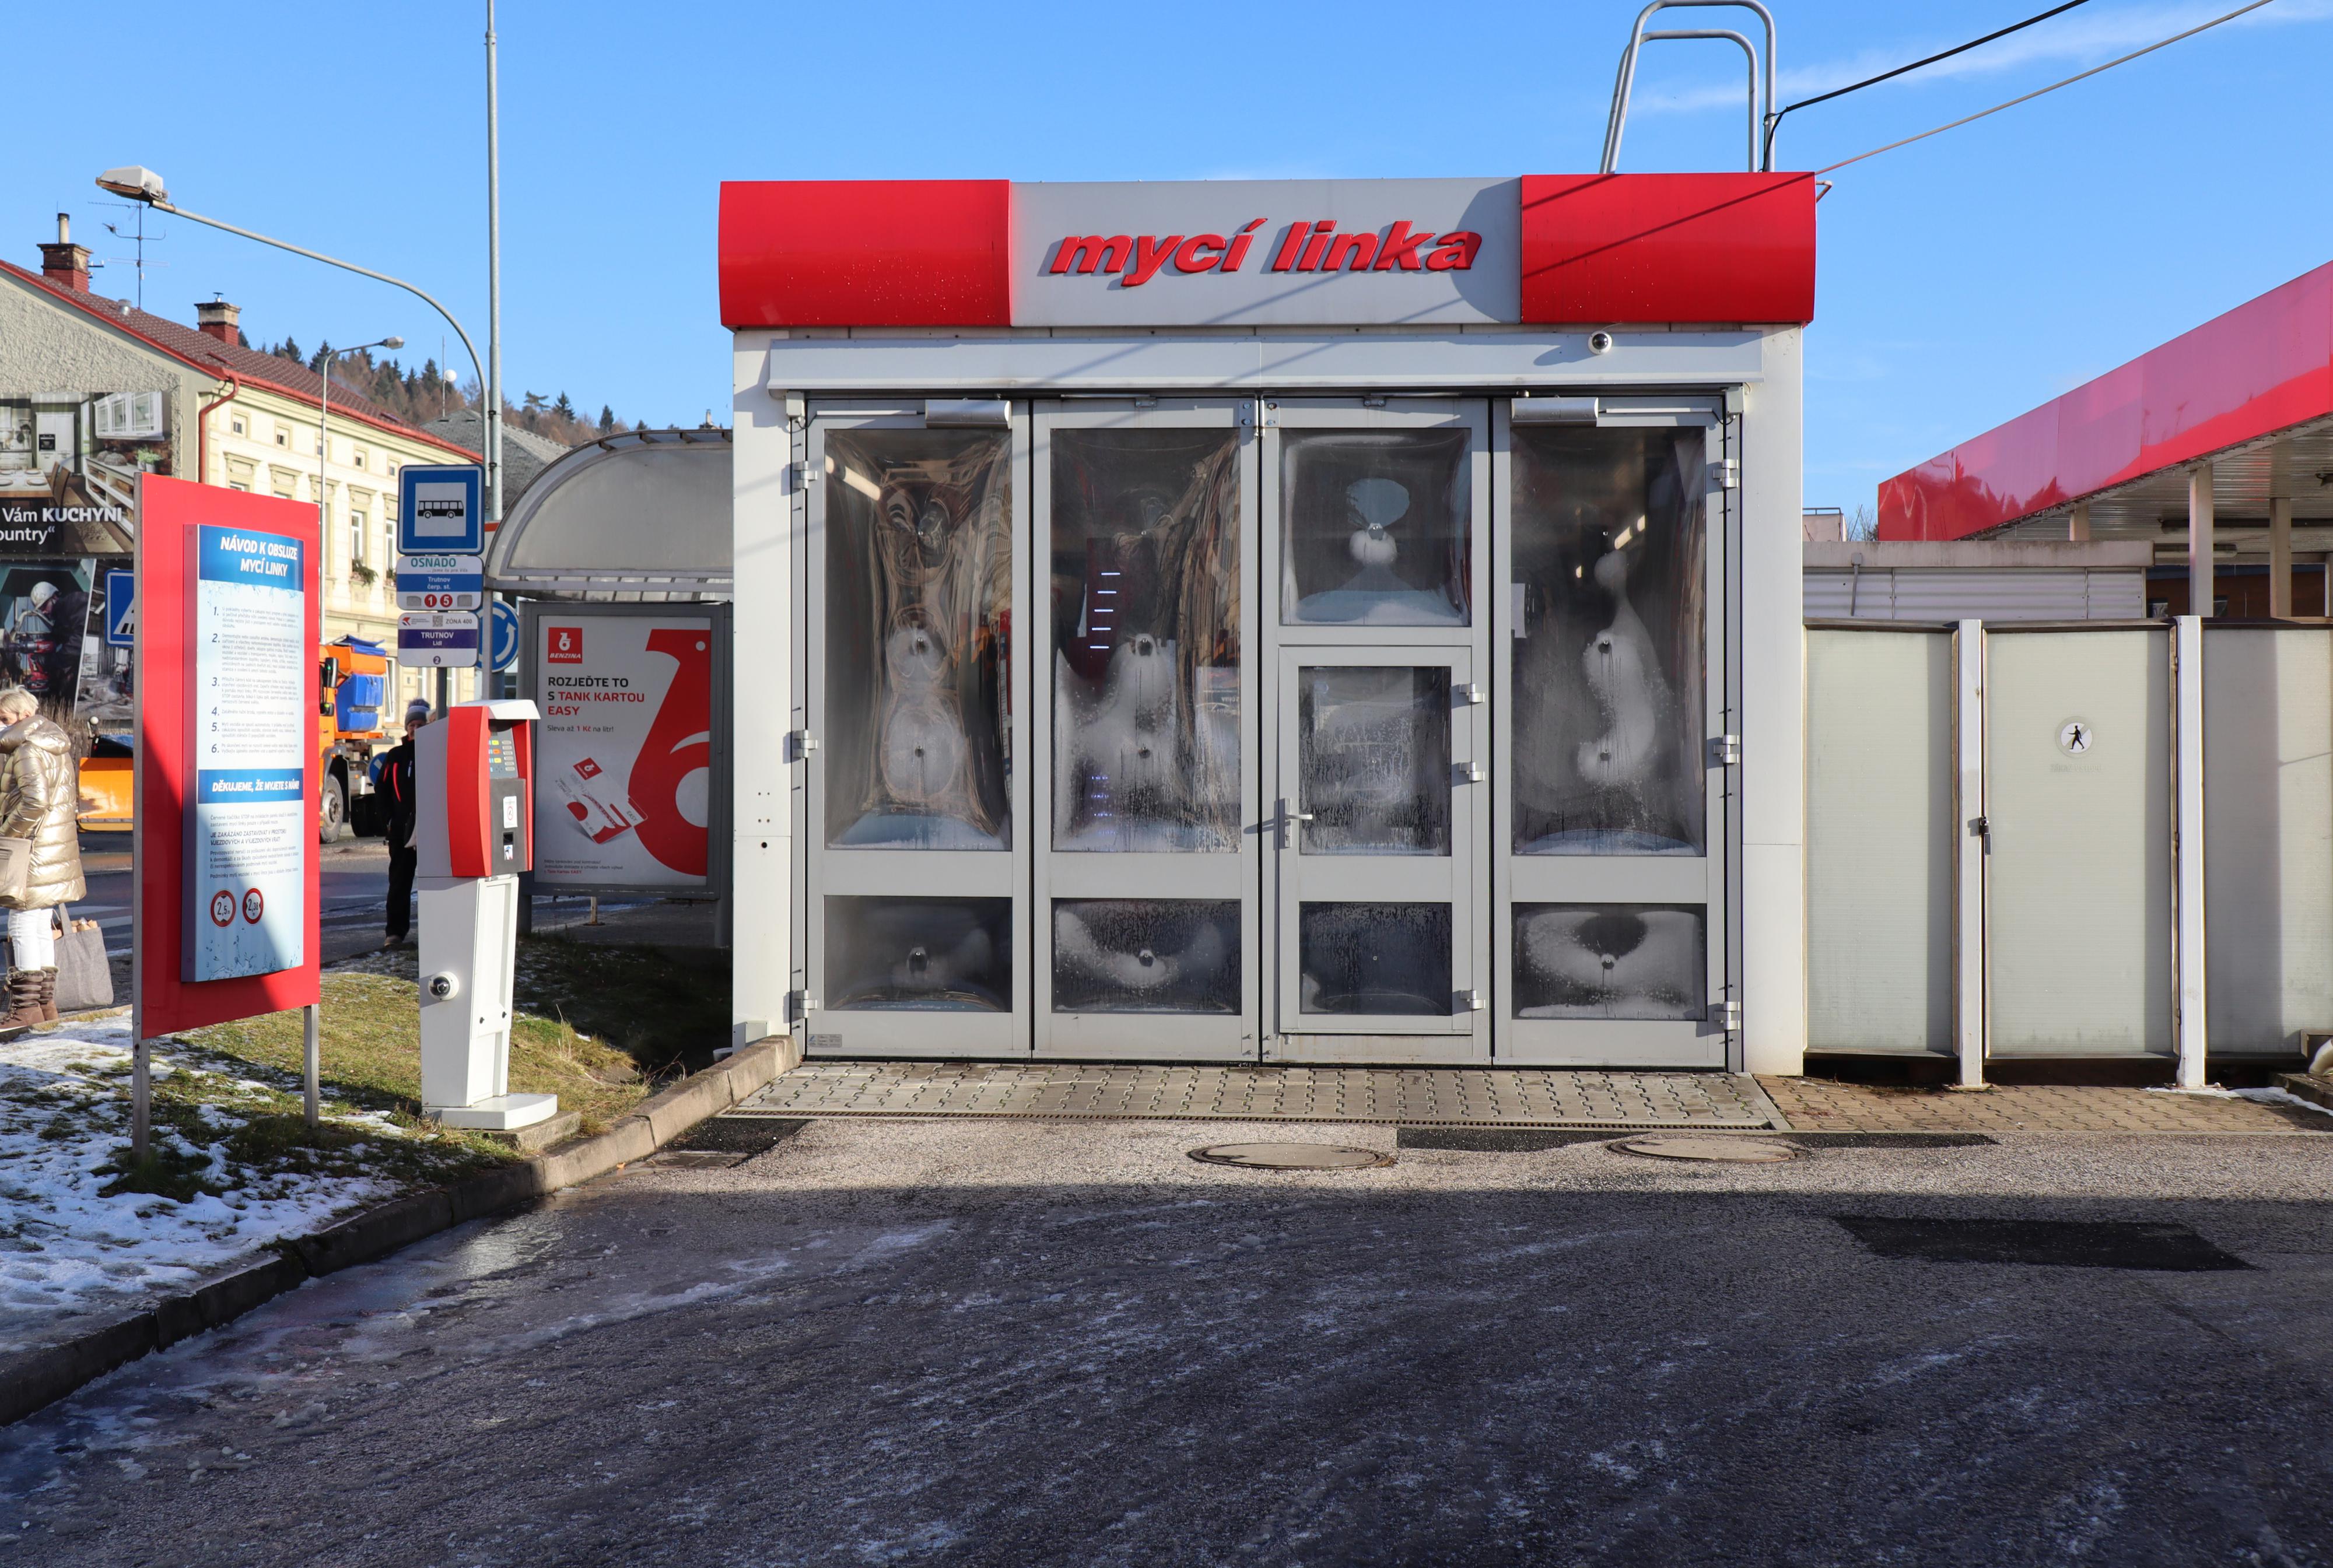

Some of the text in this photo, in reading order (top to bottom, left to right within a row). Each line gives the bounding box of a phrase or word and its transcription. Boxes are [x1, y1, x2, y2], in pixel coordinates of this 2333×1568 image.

[1049, 218, 1483, 287] mycí linka
[2, 507, 122, 522] Vám KUCHYNI
[220, 534, 298, 560] NÁVOD K OBSLUZE
[240, 557, 288, 577] MYCÍ LINKY
[411, 557, 456, 567] OSNADO
[428, 596, 450, 606] 1 5
[214, 606, 219, 616] 1.
[212, 633, 220, 643] 2.
[212, 677, 220, 686] 3.
[548, 675, 628, 687] ROZJEĎTE TO
[548, 691, 644, 702] S TANK KARTOU
[212, 707, 219, 716] 4.
[548, 706, 580, 715] EASY
[212, 722, 219, 732] 5.
[212, 743, 219, 753] 6.
[212, 779, 254, 792] DĚKUJEME,
[255, 778, 264, 791] ŽE
[264, 780, 284, 791] MYJETE
[284, 780, 288, 790] S
[626, 811, 637, 822] EASY
